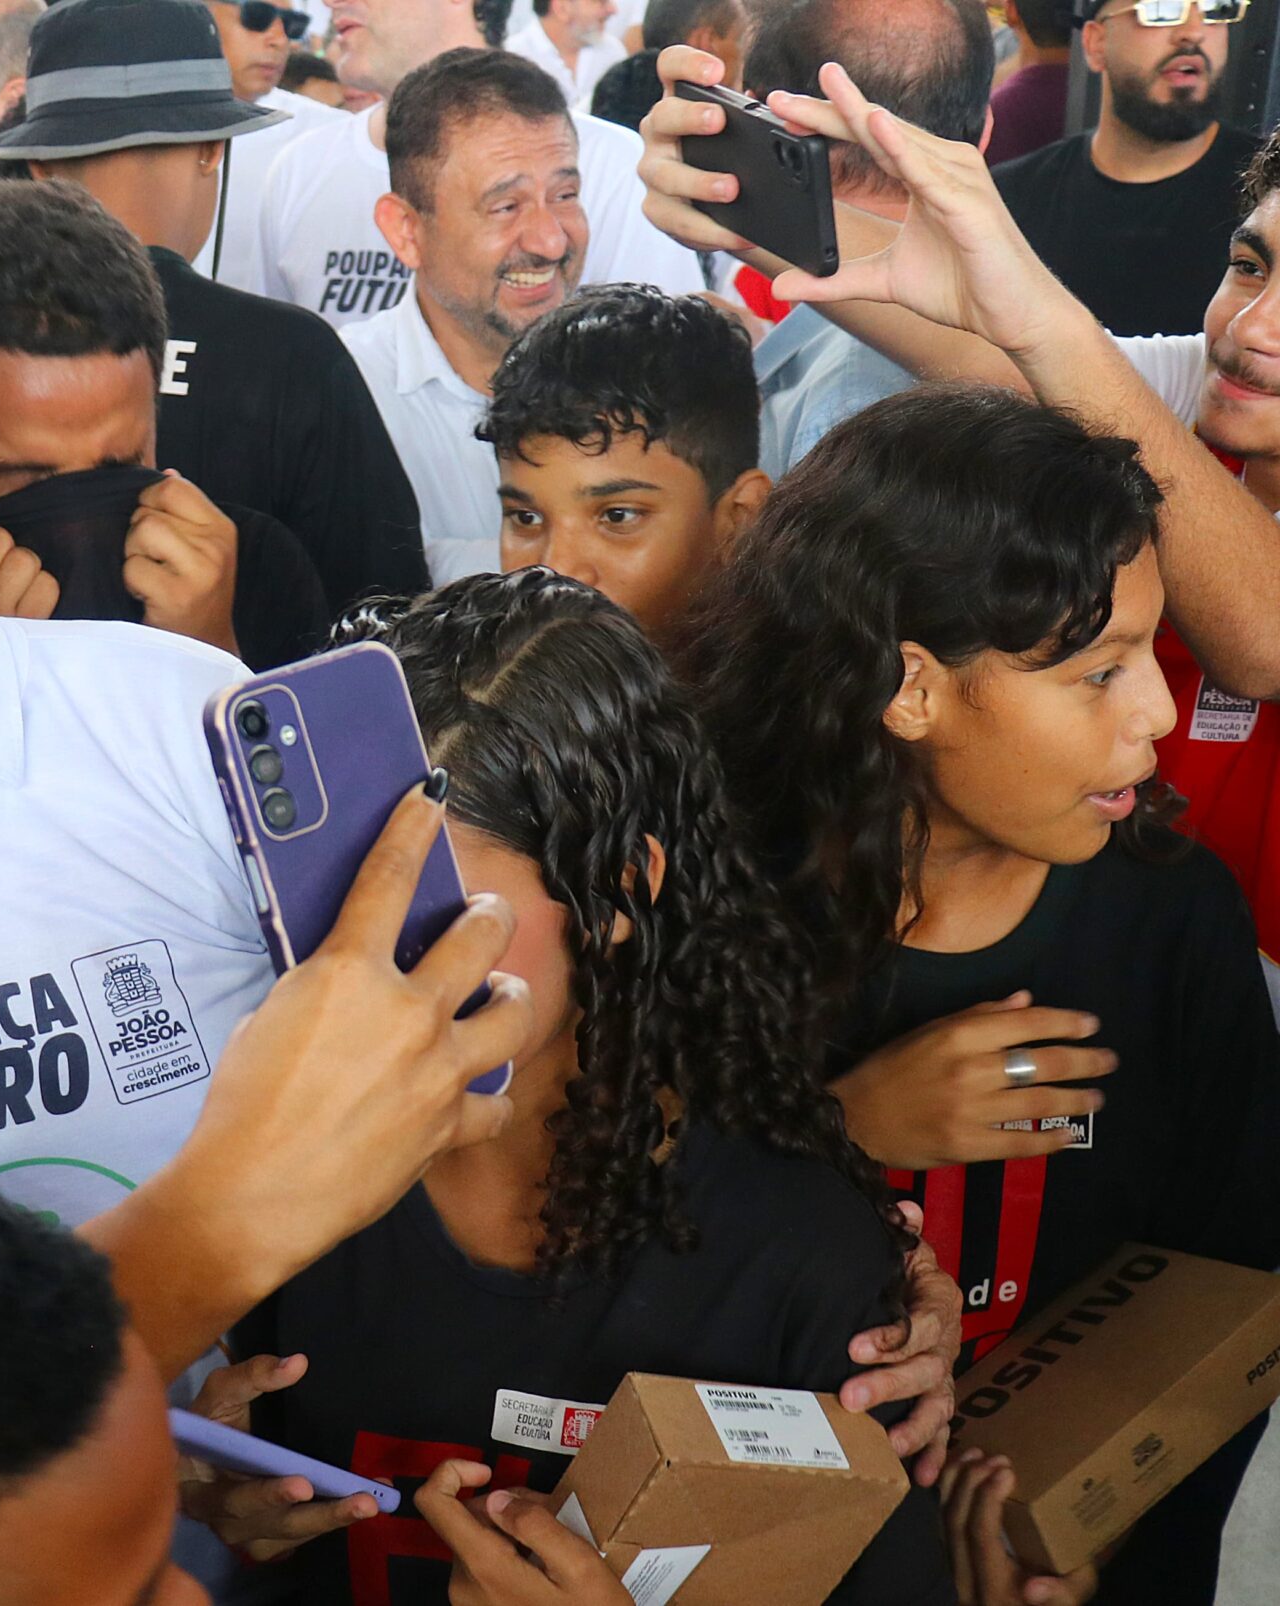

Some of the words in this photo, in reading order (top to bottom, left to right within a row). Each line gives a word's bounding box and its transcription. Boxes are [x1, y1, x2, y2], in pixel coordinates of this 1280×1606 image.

[325, 251, 411, 278] POUPA
[1197, 721, 1241, 731] EDUCAÇÃO
[1201, 731, 1240, 740] CULTURA
[116, 1009, 170, 1037] JOÃO
[108, 1020, 187, 1056] PESSOA
[130, 1040, 180, 1060] PREFEITURA
[123, 1062, 201, 1094] crescimento
[126, 1060, 169, 1082] cidade
[171, 1054, 191, 1068] em
[707, 1389, 757, 1400] POSITIVO
